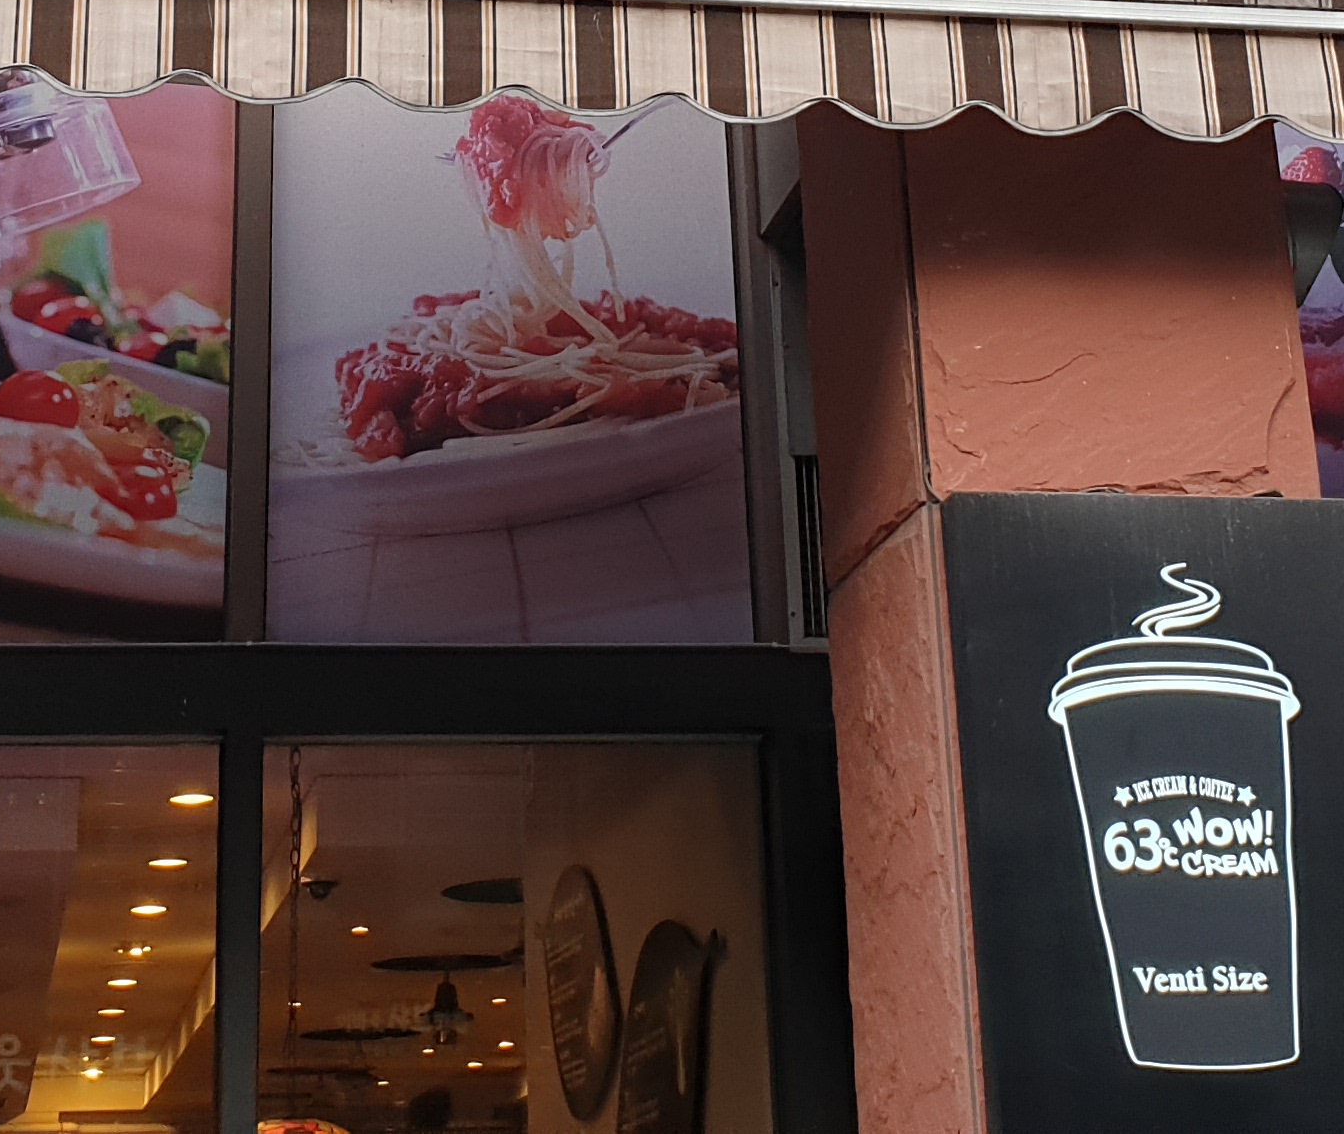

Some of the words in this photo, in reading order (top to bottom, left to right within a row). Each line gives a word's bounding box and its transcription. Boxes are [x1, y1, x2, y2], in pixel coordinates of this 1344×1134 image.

[1132, 779, 1151, 803] ICE
[1152, 775, 1188, 798] CREAM
[1189, 775, 1197, 796] &
[1198, 776, 1235, 803] COFFEE
[1172, 806, 1273, 847] WOW!
[1181, 848, 1279, 878] CREAM
[1133, 966, 1207, 994] Venti
[1212, 966, 1269, 994] Size
